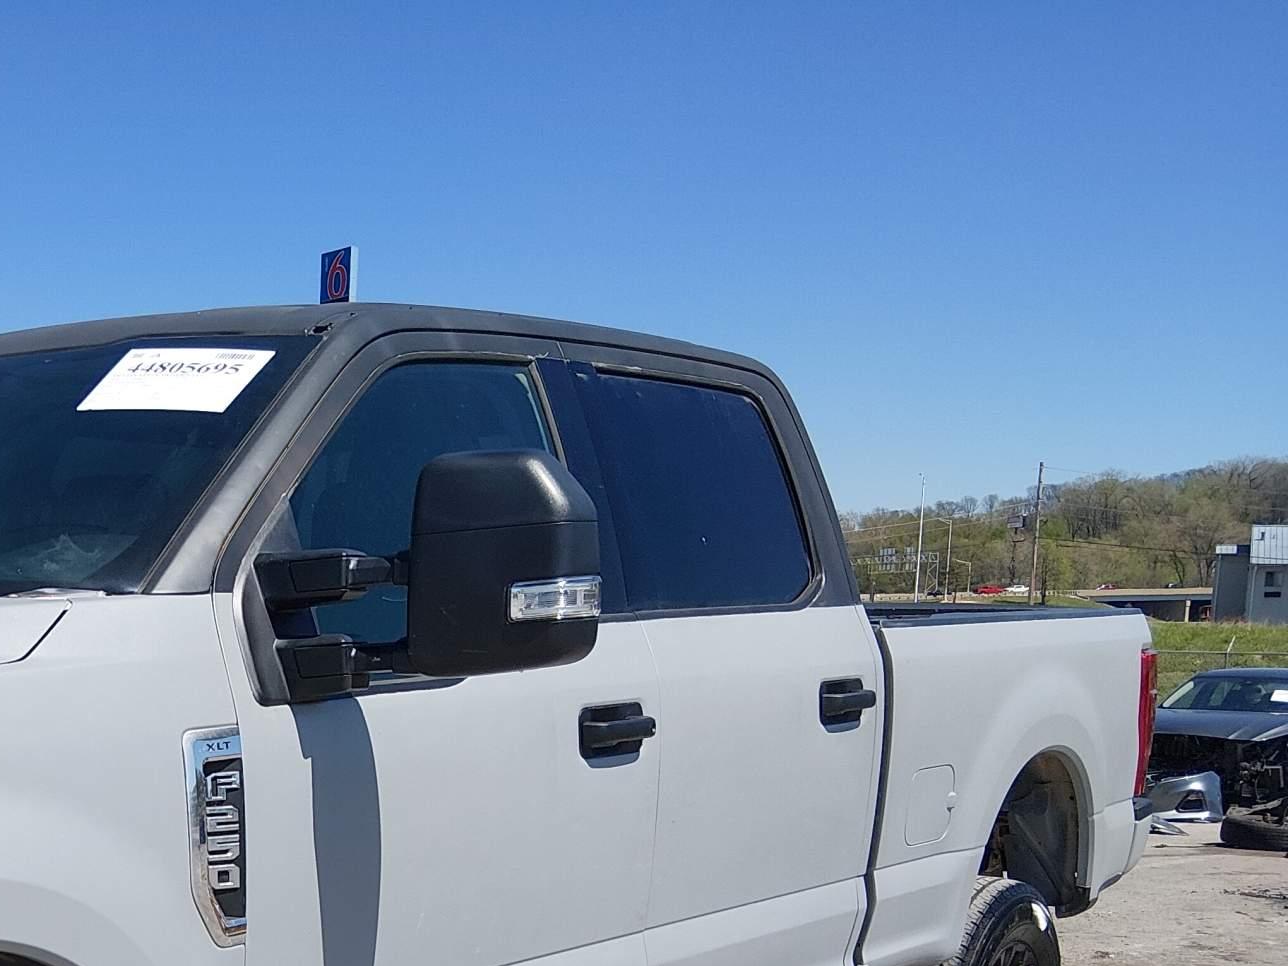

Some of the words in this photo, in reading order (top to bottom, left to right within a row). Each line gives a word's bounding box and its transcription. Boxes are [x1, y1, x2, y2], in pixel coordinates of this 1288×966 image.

[327, 250, 347, 300] 6
[127, 362, 245, 375] 44805695
[206, 741, 231, 751] XLT
